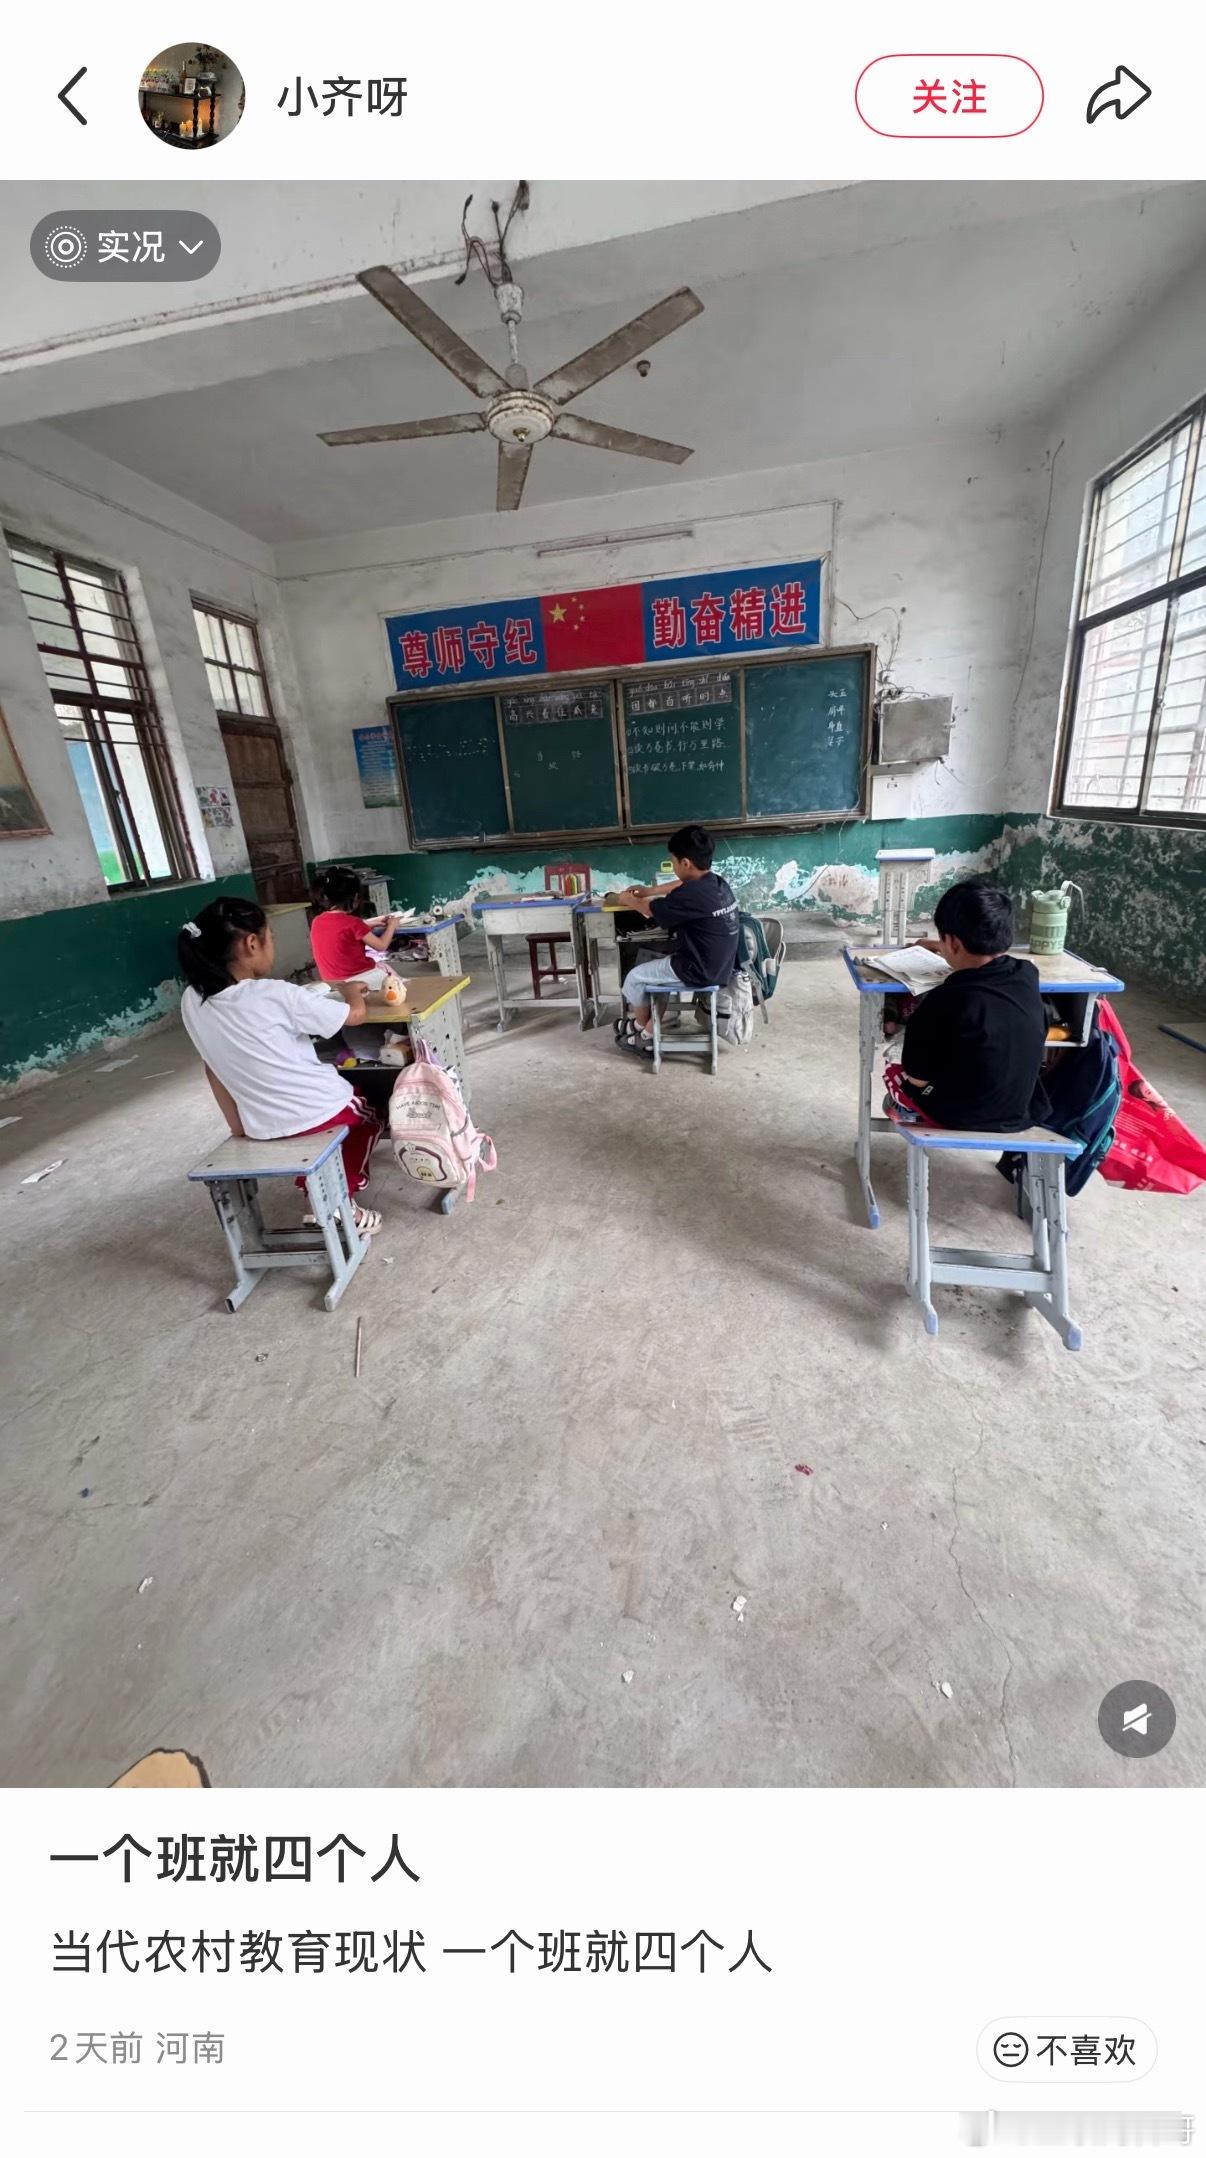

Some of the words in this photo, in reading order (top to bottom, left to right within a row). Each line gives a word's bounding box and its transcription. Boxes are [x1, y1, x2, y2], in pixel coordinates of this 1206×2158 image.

[400, 618, 537, 677] 尊师守纪
[652, 581, 807, 649] 勤奋精进
